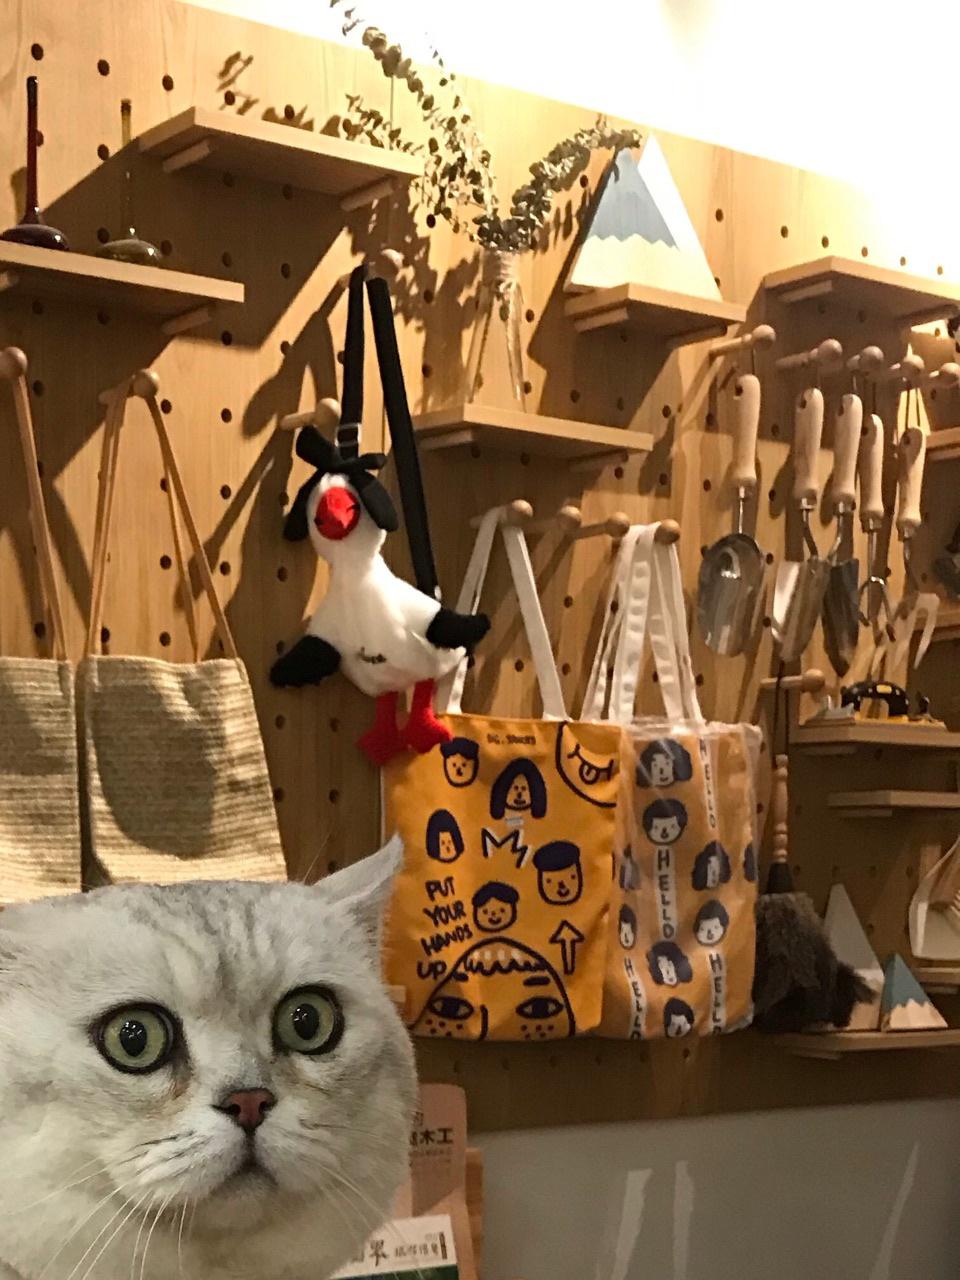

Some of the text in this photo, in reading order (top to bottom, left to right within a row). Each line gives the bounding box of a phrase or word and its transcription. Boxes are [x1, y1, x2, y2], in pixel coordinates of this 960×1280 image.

[425, 876, 456, 901] PUT
[657, 849, 675, 939] HELLO
[422, 900, 467, 928] YOUR
[420, 923, 474, 957] HANDS
[416, 960, 447, 981] UP
